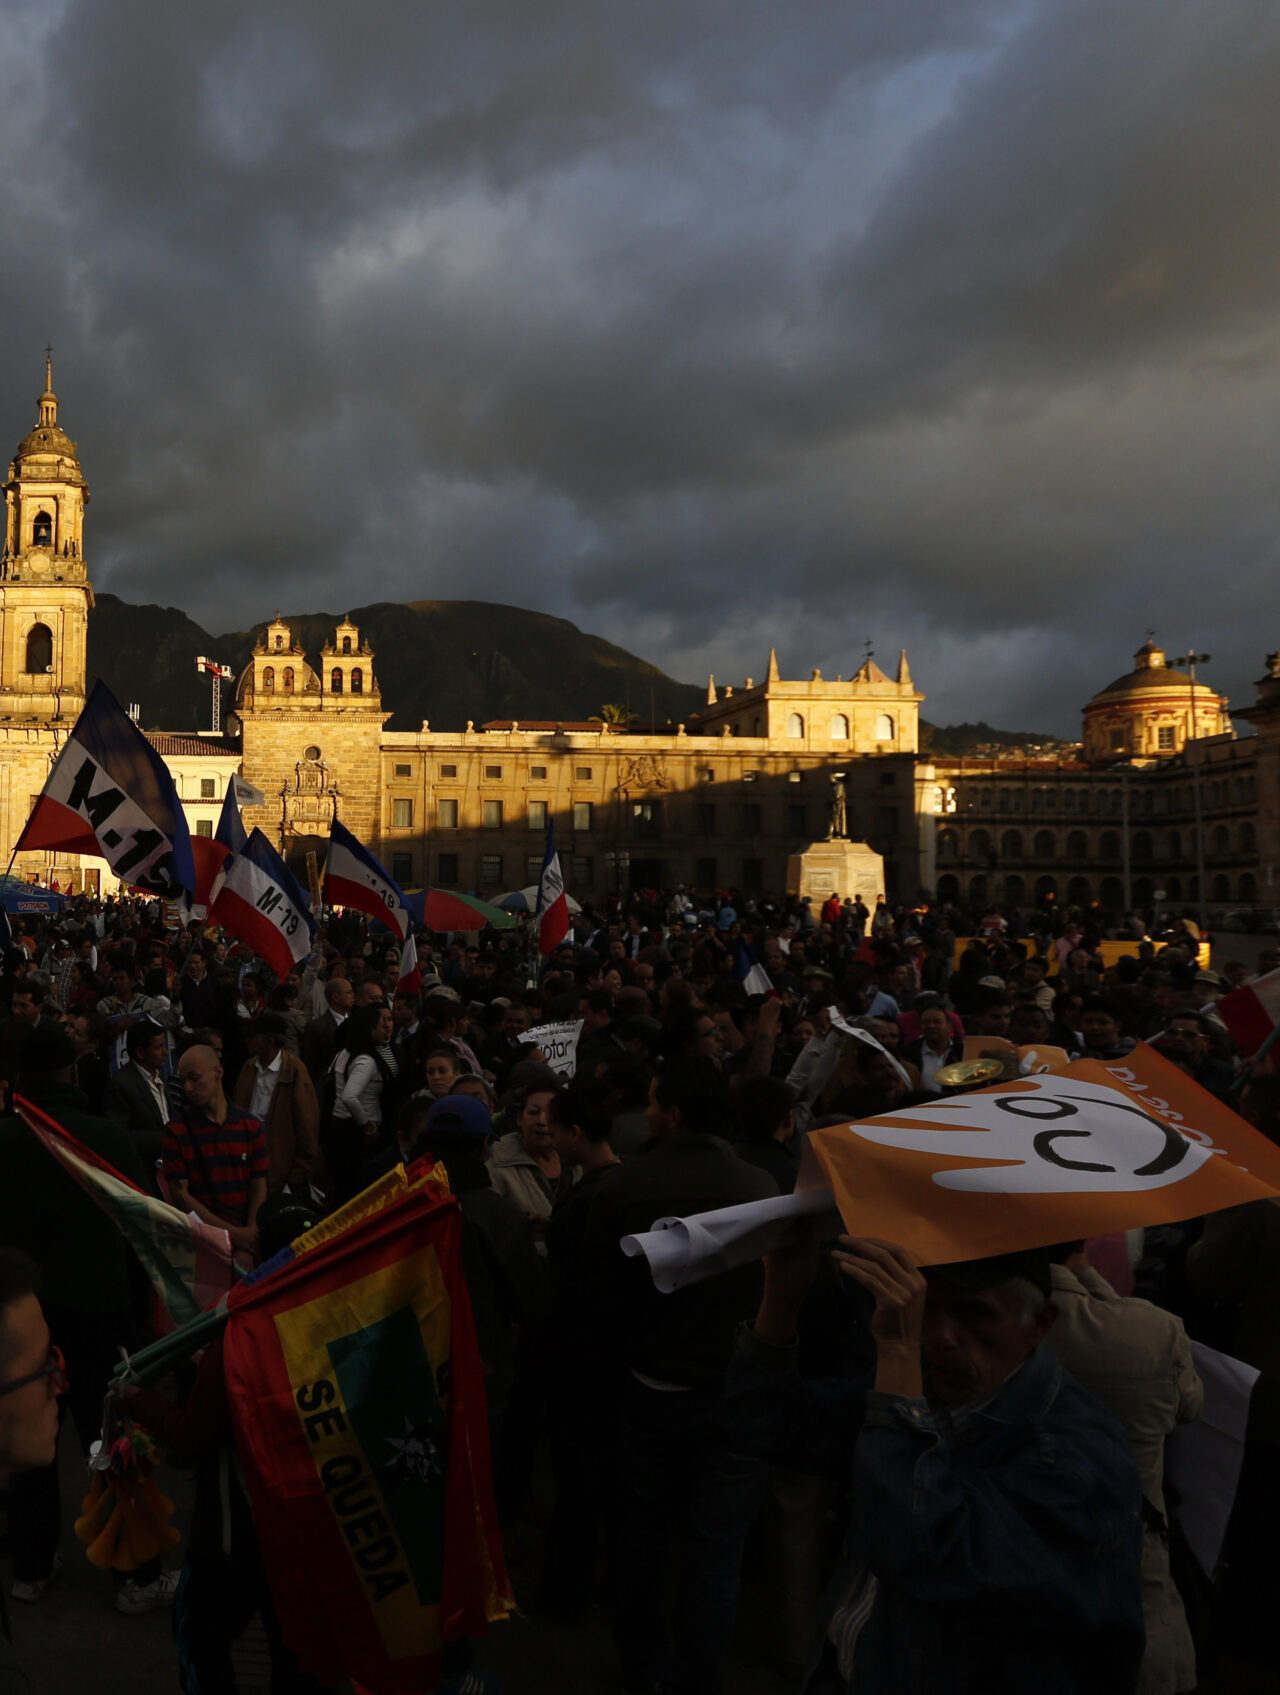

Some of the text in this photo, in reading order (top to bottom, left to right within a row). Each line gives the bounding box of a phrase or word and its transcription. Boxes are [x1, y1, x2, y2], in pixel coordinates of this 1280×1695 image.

[256, 886, 299, 936] M-19
[1104, 1066, 1150, 1093] va
[1137, 1093, 1185, 1122] se
[296, 1379, 410, 1603] SE QUEDA
